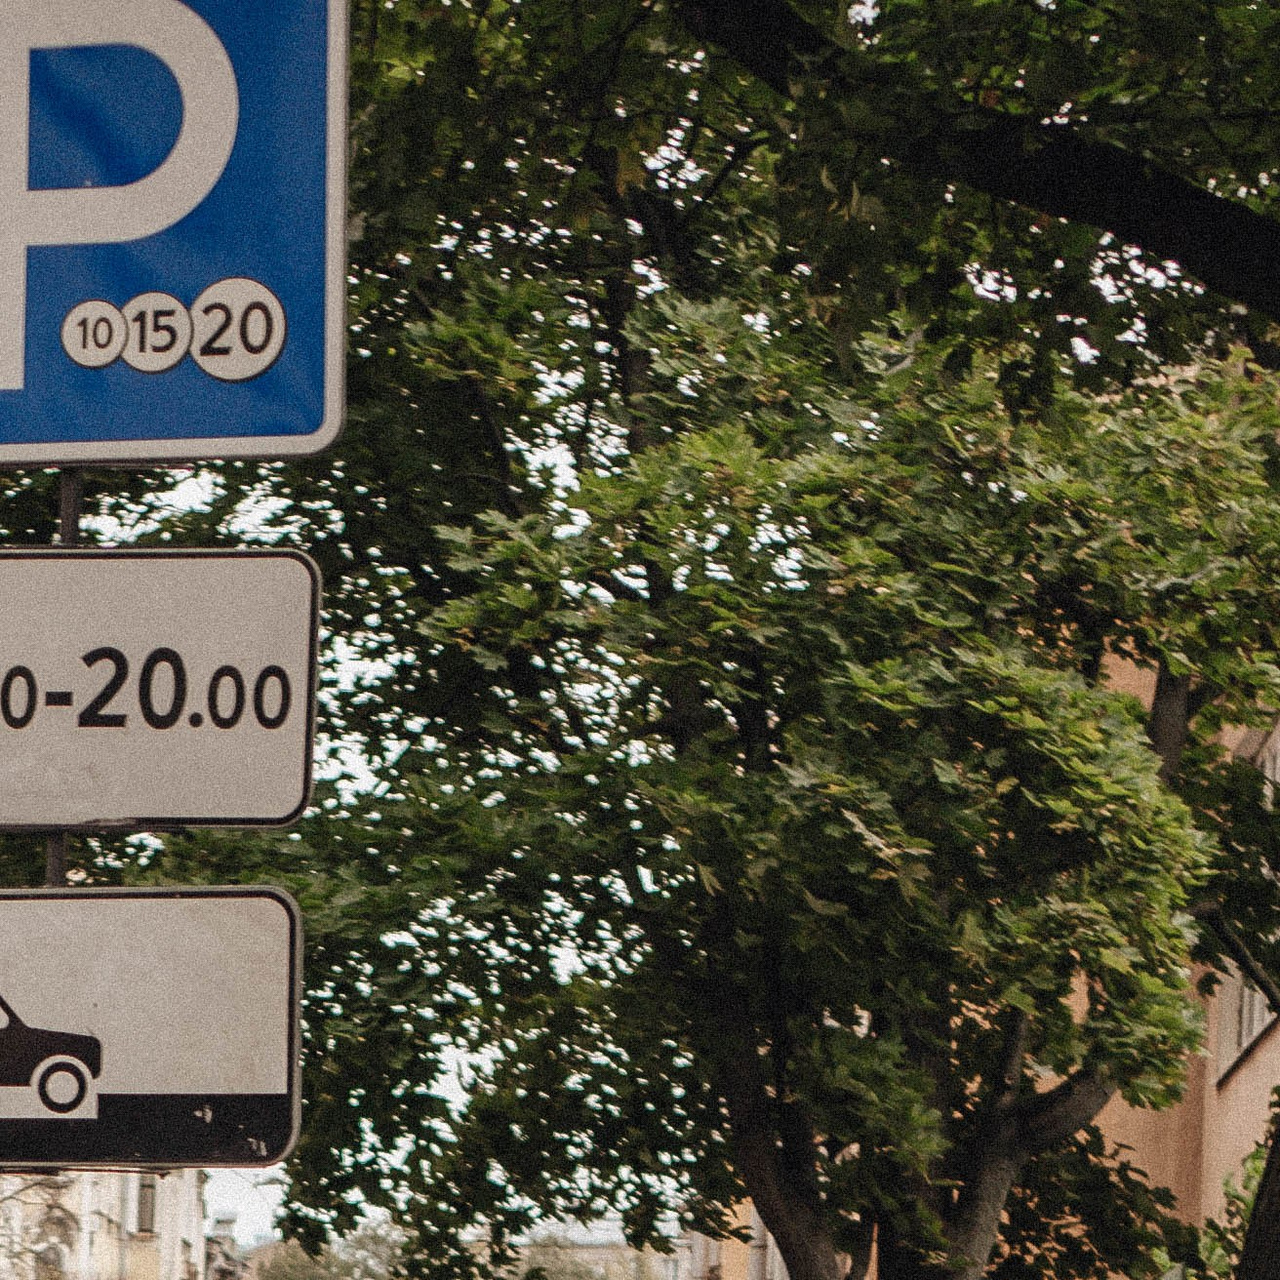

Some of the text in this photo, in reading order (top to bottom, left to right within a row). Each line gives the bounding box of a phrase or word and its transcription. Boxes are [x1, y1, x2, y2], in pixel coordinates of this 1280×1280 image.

[77, 300, 273, 357] 10 15 20
